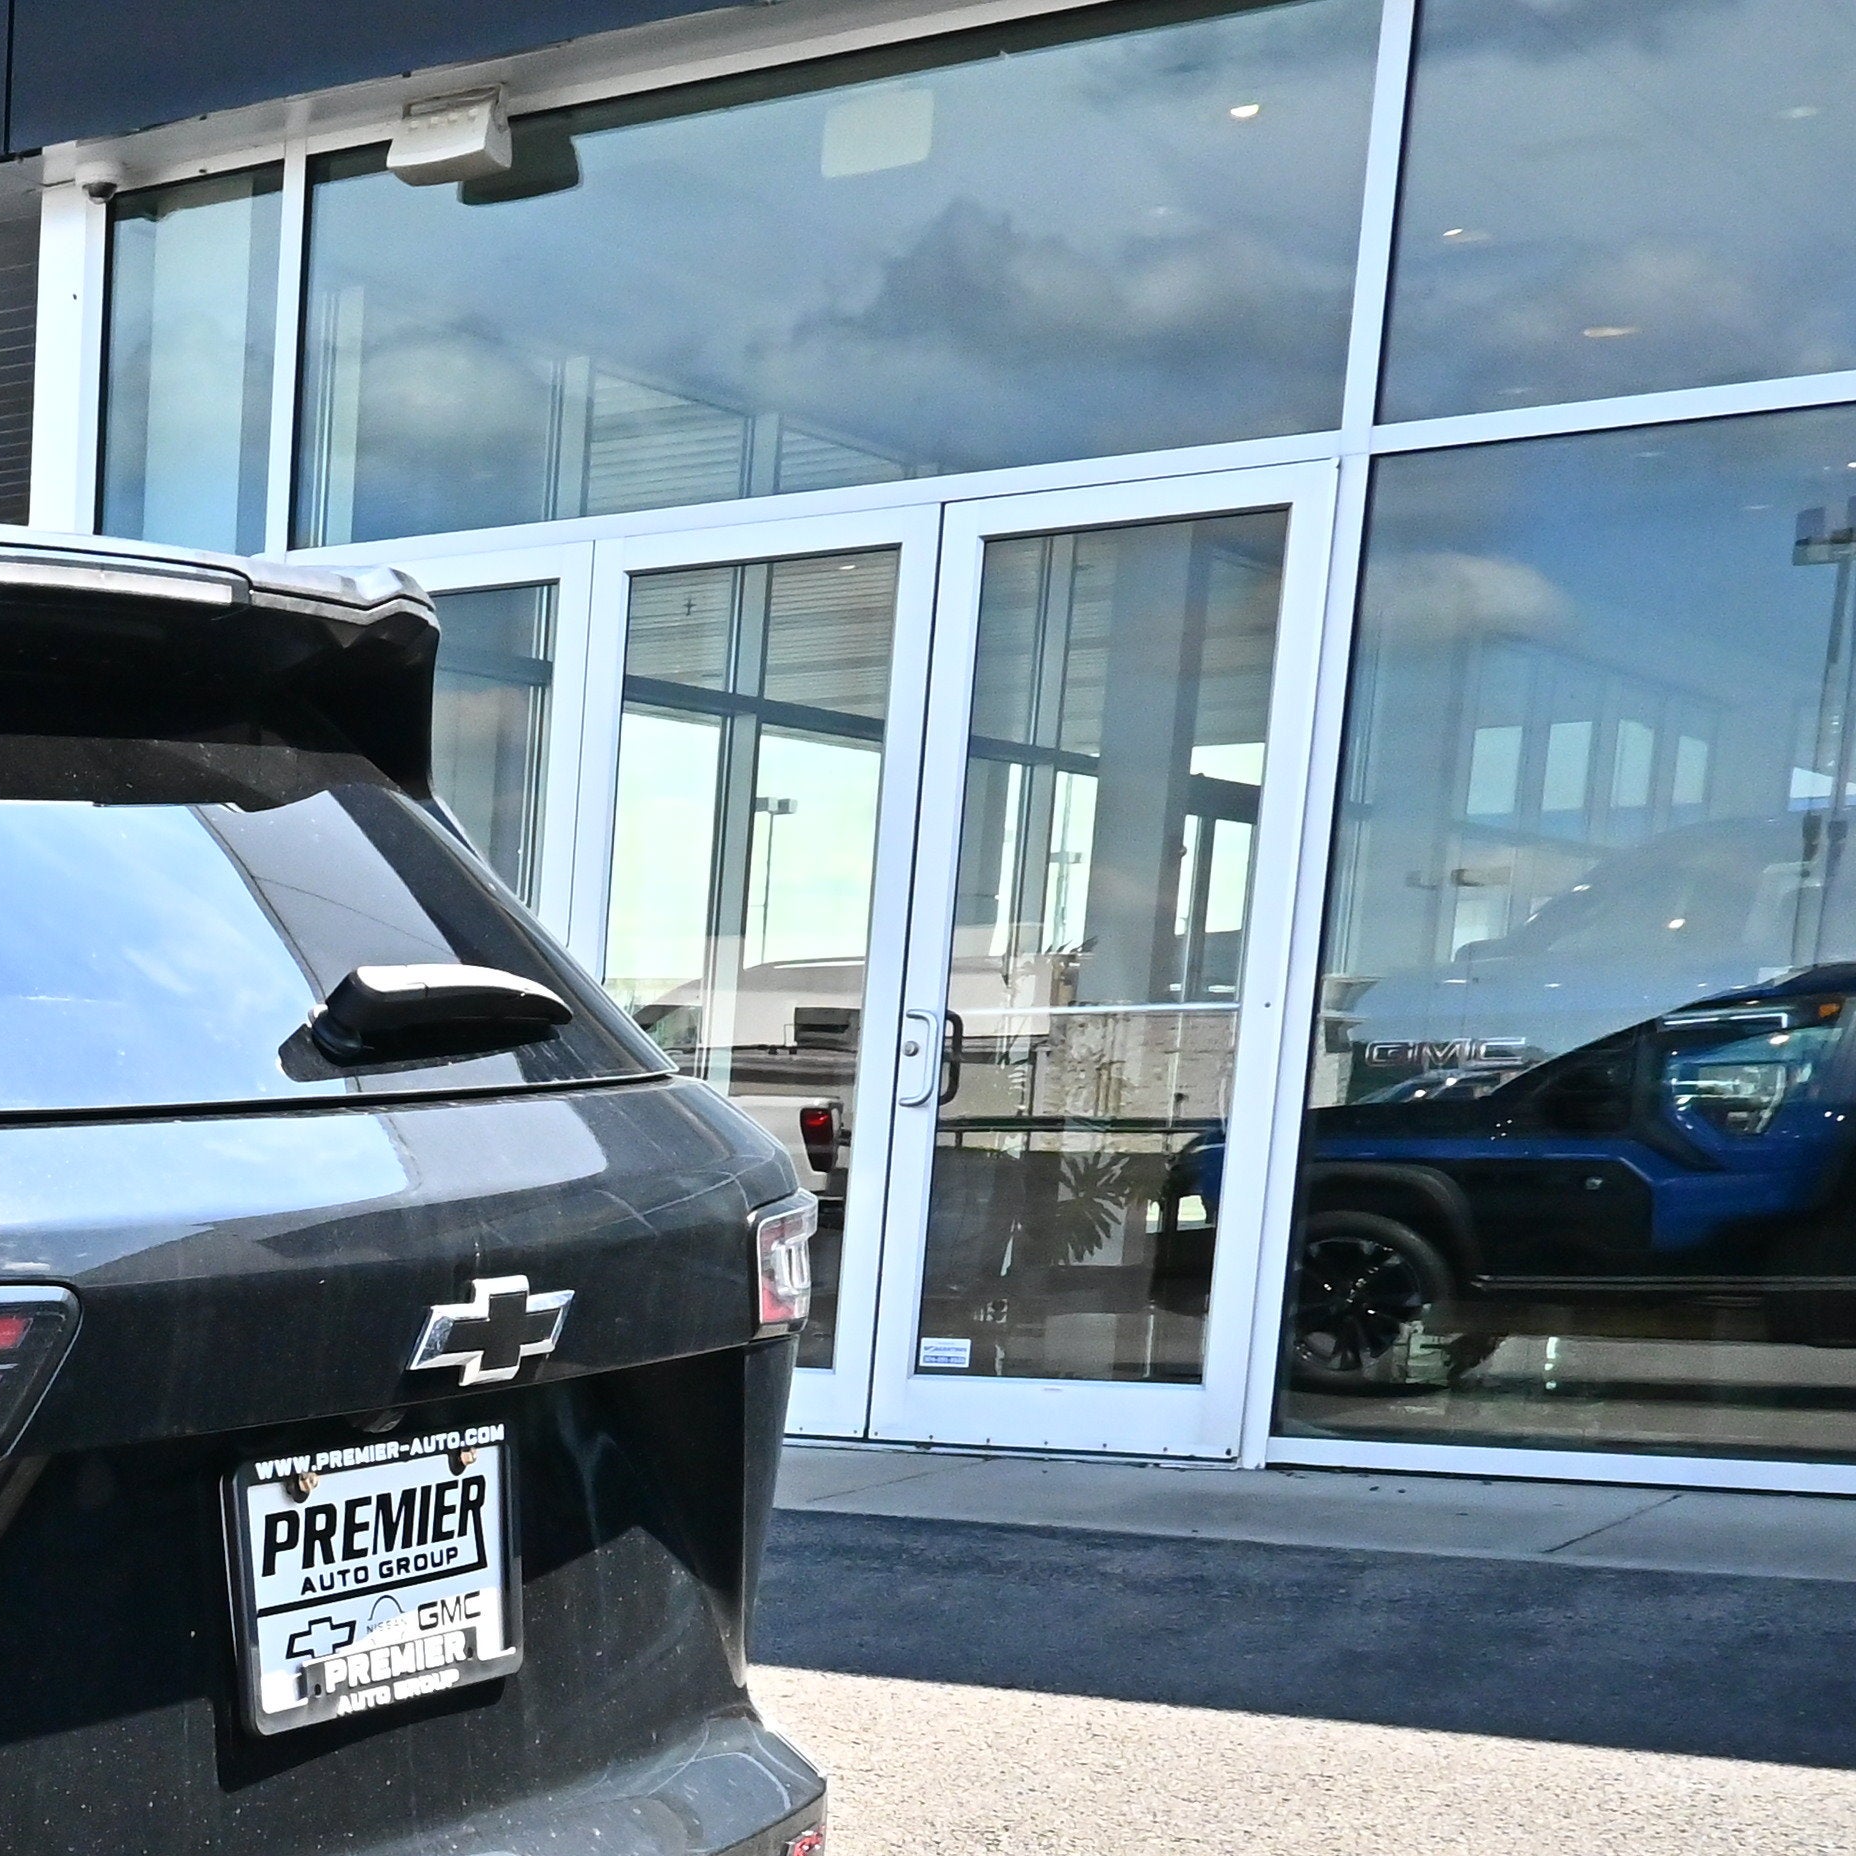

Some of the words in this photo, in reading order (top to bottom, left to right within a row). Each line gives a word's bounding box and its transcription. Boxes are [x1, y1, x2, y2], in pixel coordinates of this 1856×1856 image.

[1365, 1036, 1526, 1067] GMC
[255, 1424, 505, 1480] WWW.PREMIER-AUTO.COM
[261, 1474, 488, 1577] PREMIER
[301, 1565, 369, 1595] AUTO
[378, 1546, 459, 1578] GROUP
[417, 1591, 481, 1631] GMC
[324, 1630, 466, 1694] PREMIER
[336, 1685, 392, 1716] AUTO
[394, 1668, 460, 1700] GROUP
